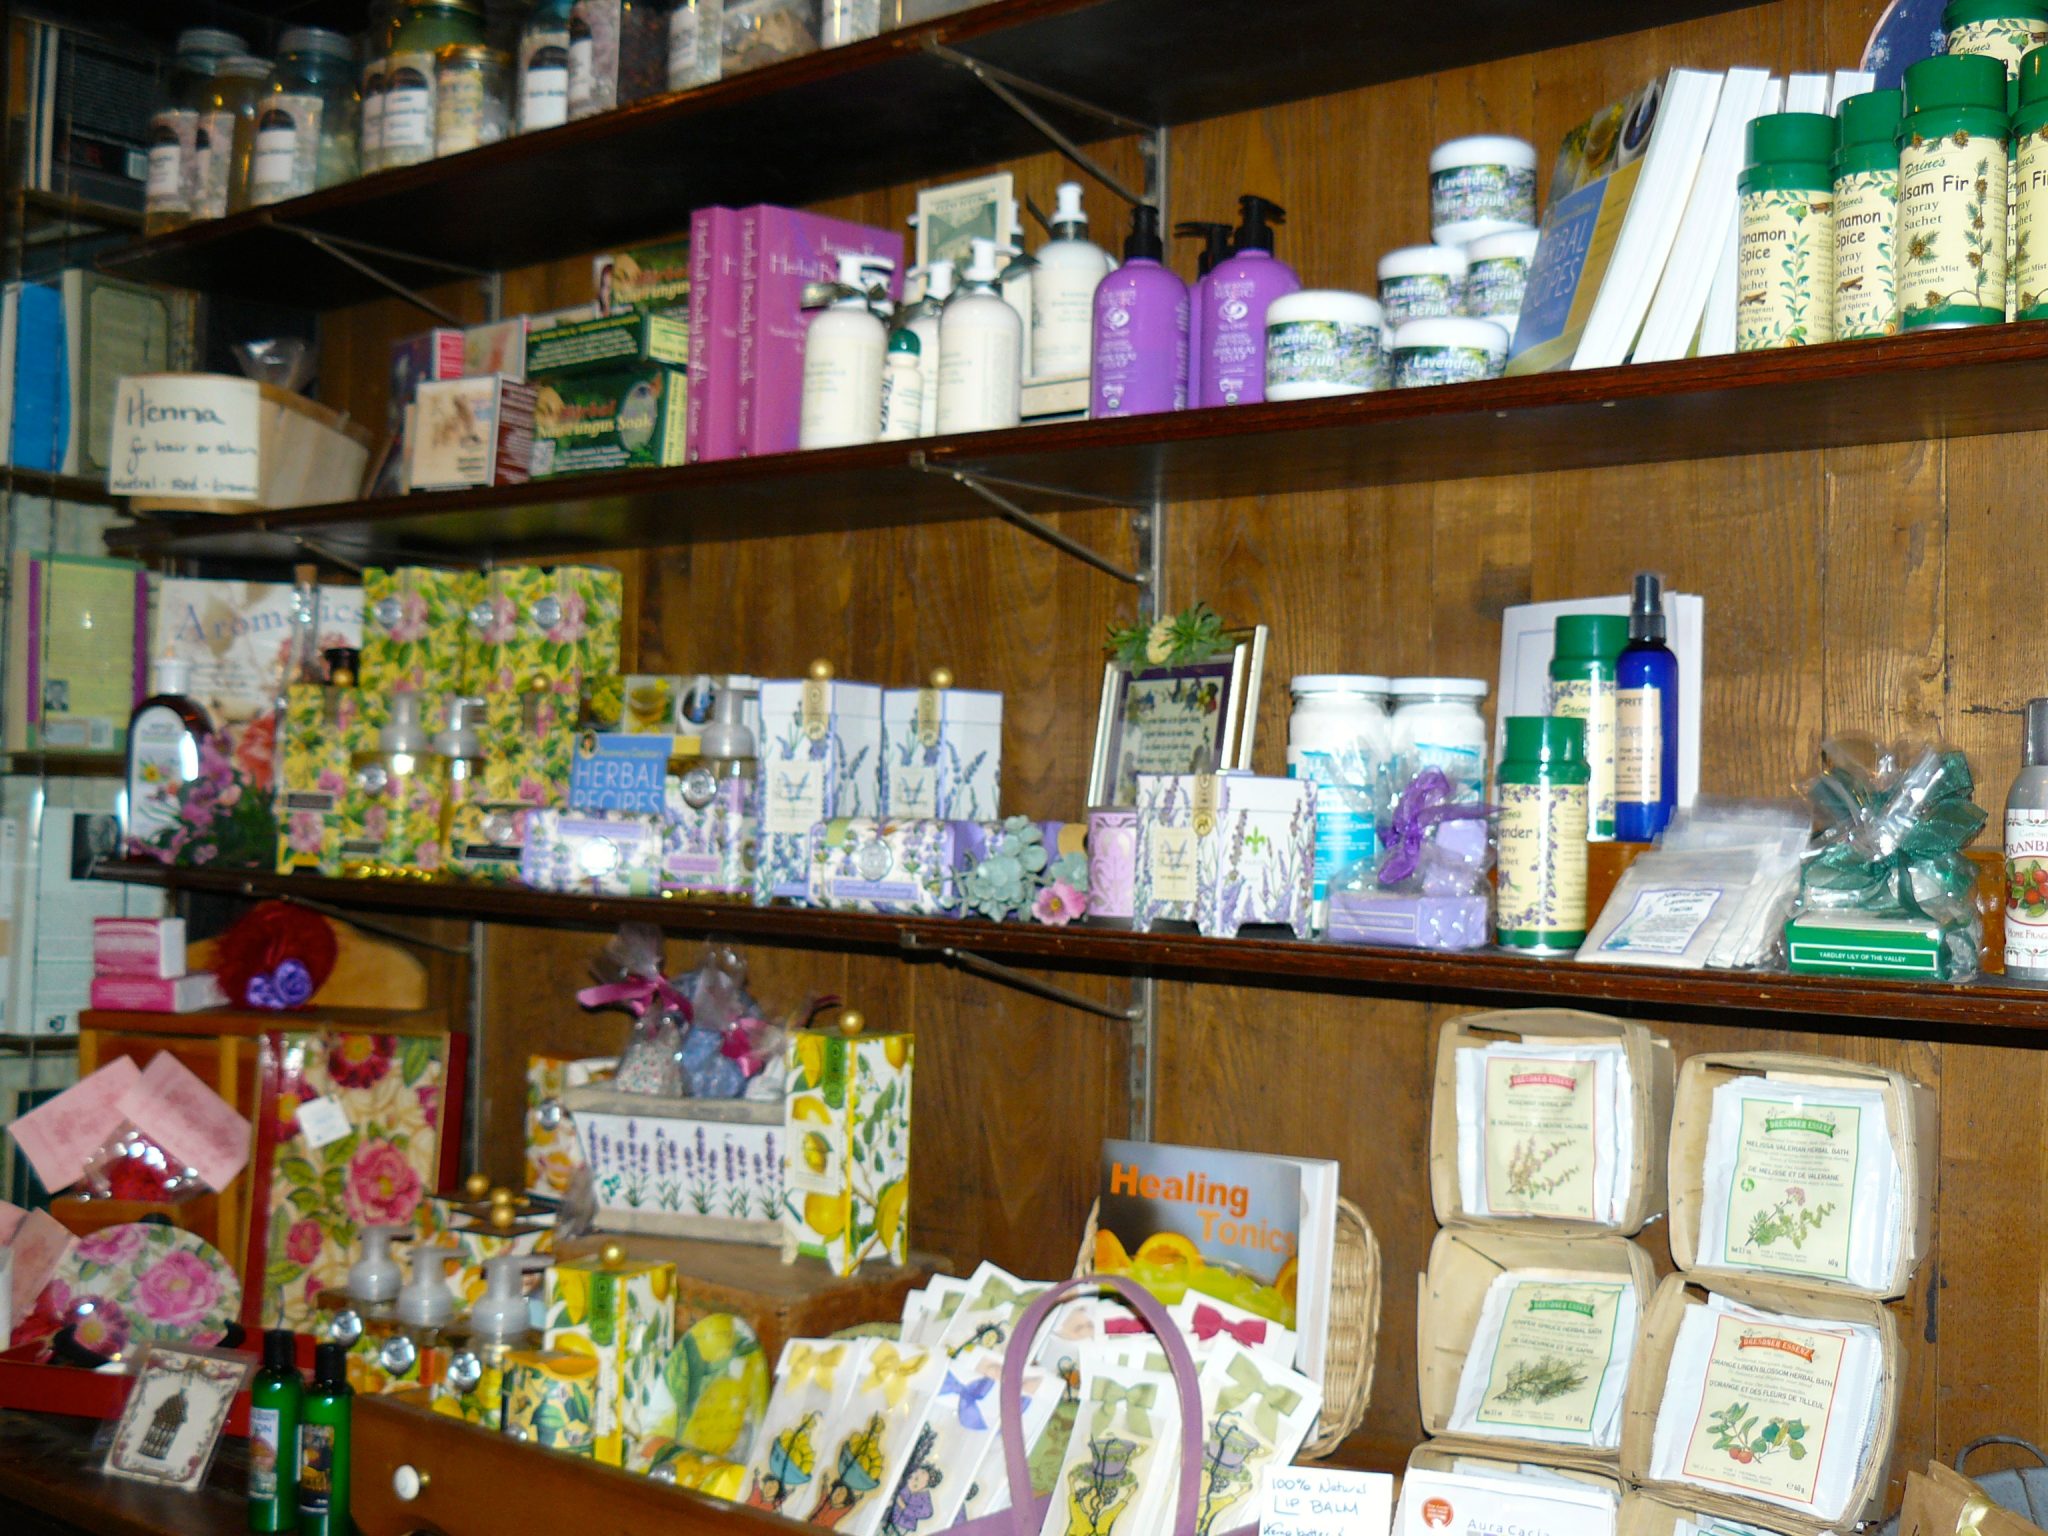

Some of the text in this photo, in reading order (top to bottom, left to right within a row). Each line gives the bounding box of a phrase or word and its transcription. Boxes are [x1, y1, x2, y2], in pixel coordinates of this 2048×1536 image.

[1905, 158, 1945, 177] Daine's
[1438, 173, 1496, 190] Lavender
[1898, 175, 1970, 203] alsam Fir
[1465, 194, 1506, 208] Scrub
[1906, 201, 1939, 216] Spray
[1836, 211, 1881, 229] nnamon
[1904, 215, 1943, 231] Sachet
[1741, 229, 1787, 246] nnamon
[1383, 282, 1439, 300] Lavender
[1409, 303, 1448, 318] Scrub
[1268, 331, 1324, 349] Lavender
[1293, 351, 1336, 368] Scrub
[1413, 354, 1480, 371] Lavender
[127, 388, 225, 428] Henna
[576, 761, 663, 791] HERBAL
[574, 790, 661, 813] RECIPES
[1819, 952, 1846, 960] YARDLEY
[1847, 953, 1860, 961] LILY
[1746, 1140, 1774, 1150] MELISSA
[1776, 1143, 1806, 1153] VALERIAN
[1806, 1146, 1829, 1154] HERBAL
[1758, 1167, 1786, 1178] MELISSE
[1111, 1162, 1249, 1218] Healing
[1197, 1210, 1297, 1257] Tonics
[1743, 1337, 1811, 1357] DRESDNER ESSENZ
[1711, 1358, 1736, 1369] ORANGE
[1737, 1363, 1759, 1373] LINDEN
[1759, 1366, 1788, 1378] BLOSSOM
[1789, 1371, 1815, 1383] HERBAL
[1815, 1377, 1833, 1388] BATH
[1741, 1385, 1749, 1393] ET
[1750, 1387, 1762, 1396] DES
[1763, 1390, 1787, 1400] FLEURS
[1788, 1394, 1797, 1402] DE
[1799, 1396, 1825, 1410] TILLEUL
[1272, 1478, 1312, 1492] 100%
[1310, 1500, 1358, 1516] BALM
[1468, 1519, 1503, 1533] Aura
